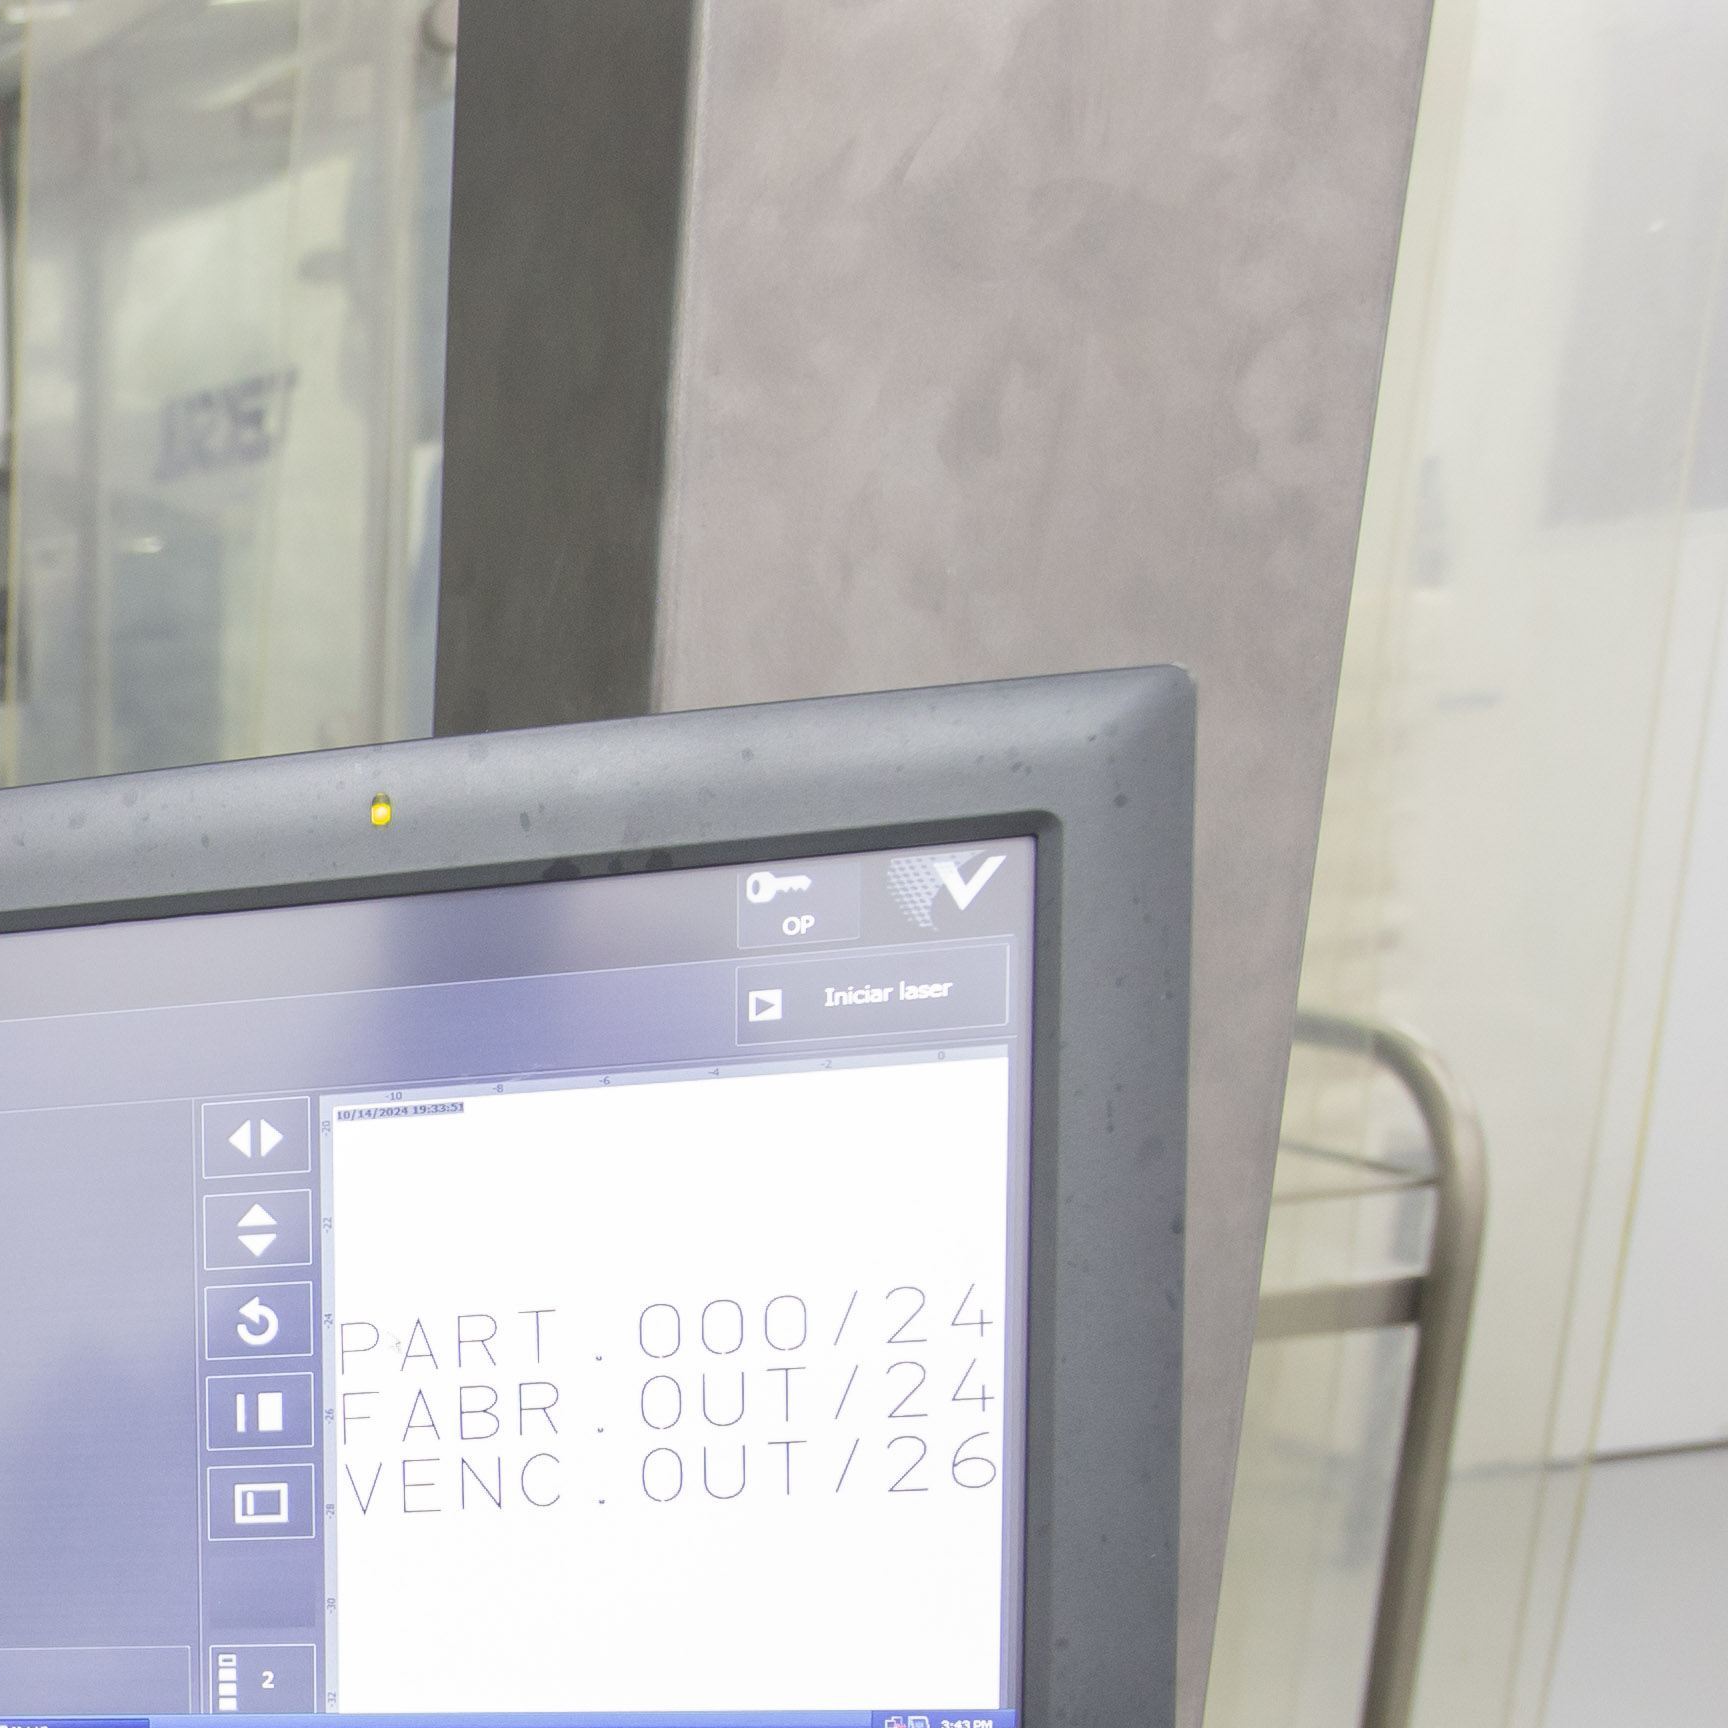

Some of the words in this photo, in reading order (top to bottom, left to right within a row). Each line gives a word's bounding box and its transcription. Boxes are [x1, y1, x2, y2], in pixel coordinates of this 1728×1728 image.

[782, 915, 815, 936] OP
[824, 986, 894, 1007] Iniciar
[899, 981, 953, 1001] laser
[385, 1091, 403, 1101] -10
[599, 1076, 611, 1085] -6
[708, 1068, 720, 1077] -4
[337, 1106, 409, 1122] 10/14/2024
[261, 1670, 275, 1689] 2
